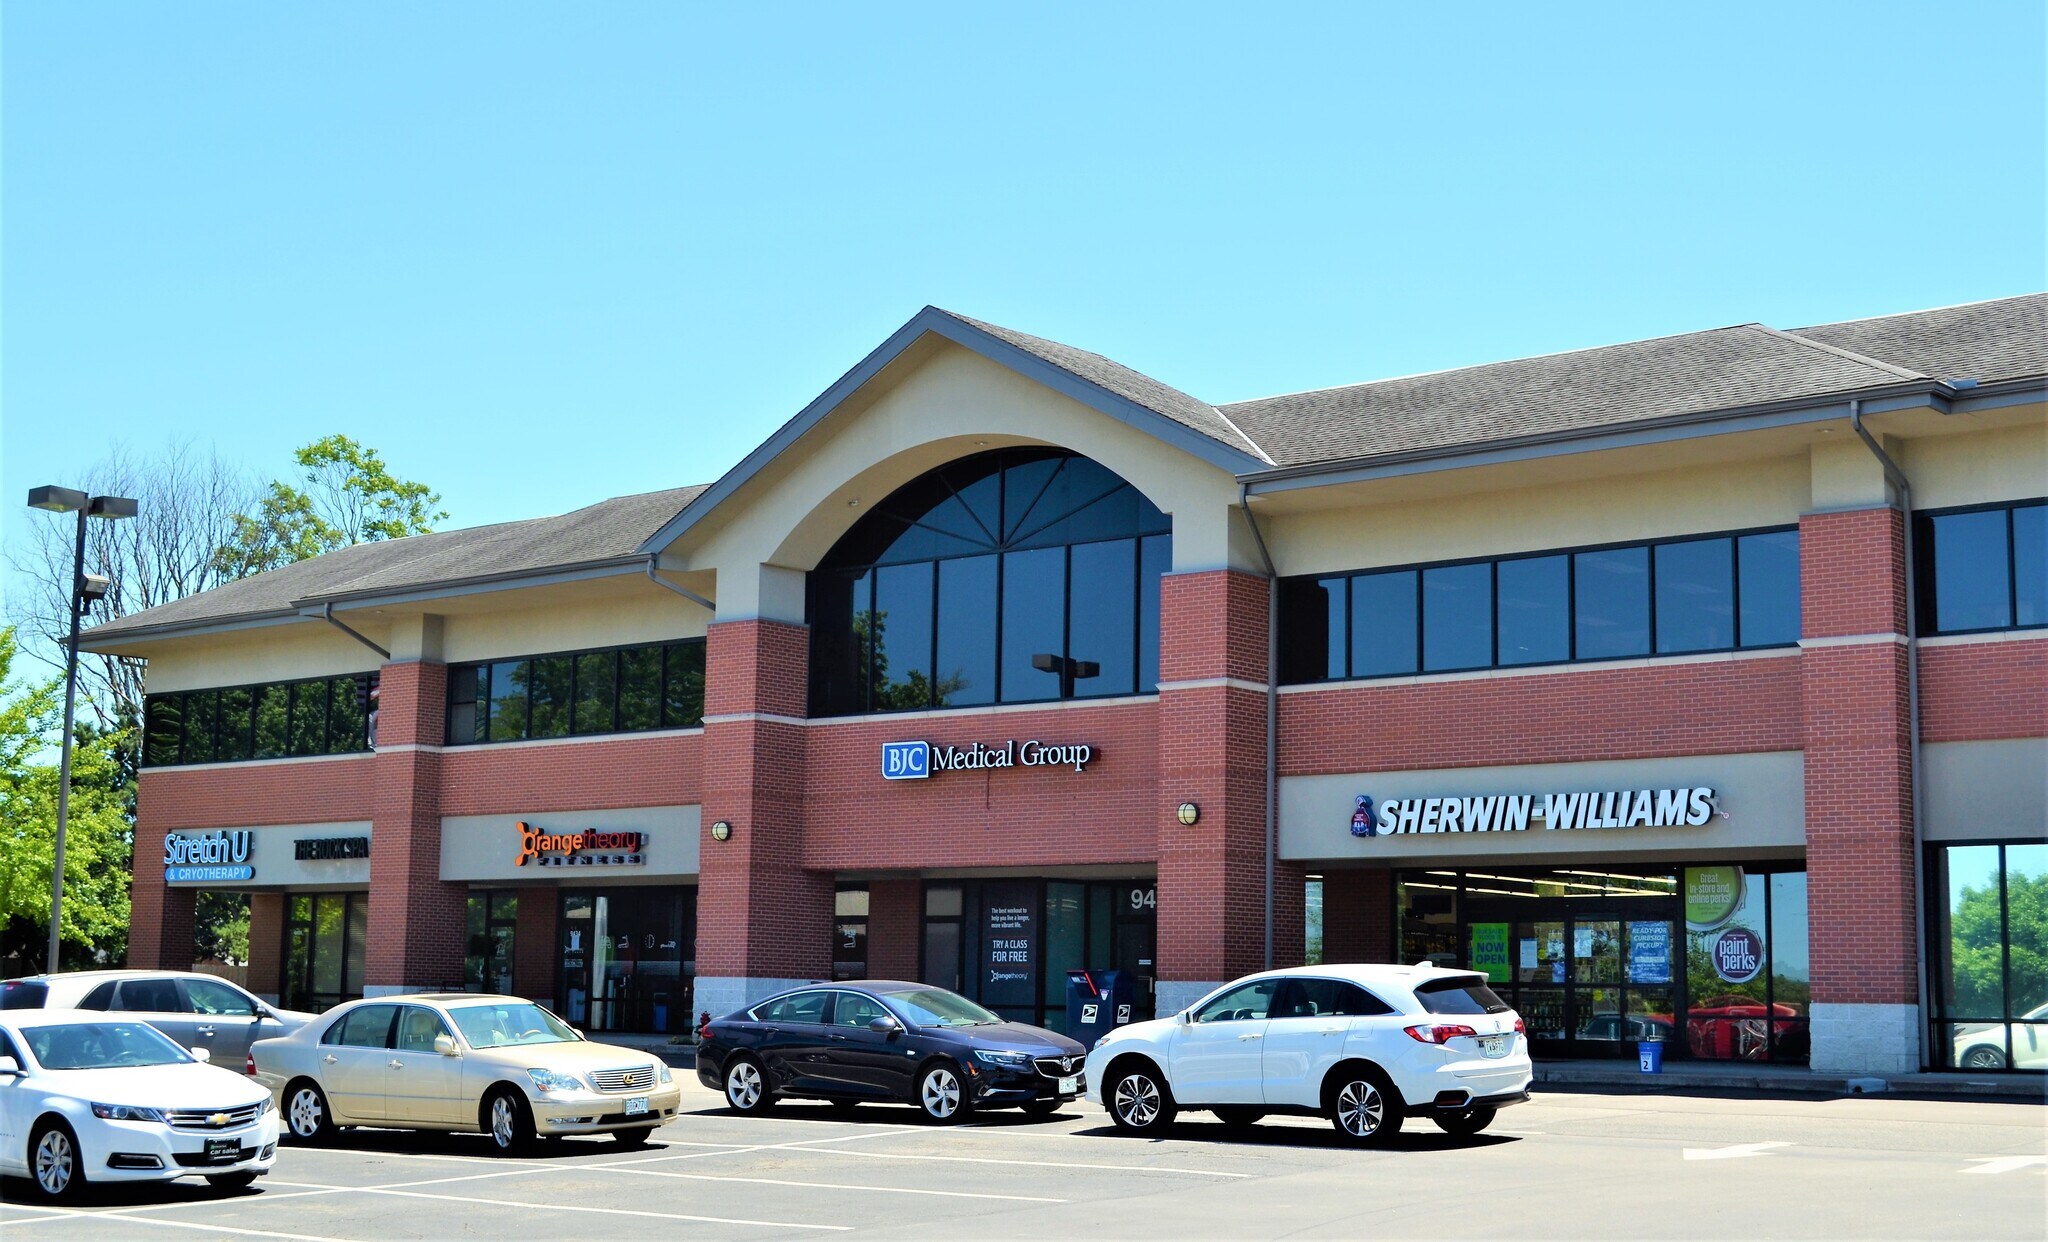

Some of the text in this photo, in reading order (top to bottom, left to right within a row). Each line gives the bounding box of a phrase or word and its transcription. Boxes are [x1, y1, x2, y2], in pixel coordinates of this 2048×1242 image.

[889, 739, 1091, 775] BJC Medical Group
[1376, 787, 1715, 835] SHERWIN-WILLIAMS
[164, 831, 249, 864] Stretch U
[294, 840, 313, 860] THE
[314, 839, 342, 859] ROCK
[515, 821, 641, 866] Orangetheory
[538, 854, 641, 866] FITNESS
[169, 867, 246, 880] & CRYOTHERAPY
[1700, 873, 1718, 883] Great
[1716, 883, 1730, 893] and
[1688, 894, 1709, 903] online
[992, 940, 1028, 949] TRY A CLASS
[1477, 942, 1504, 952] NOW
[1719, 937, 1749, 957] paint
[992, 951, 1028, 962] FOR FREE
[1476, 954, 1506, 964] OPEN
[1723, 953, 1755, 972] perks
[1643, 1060, 1649, 1070] 2
